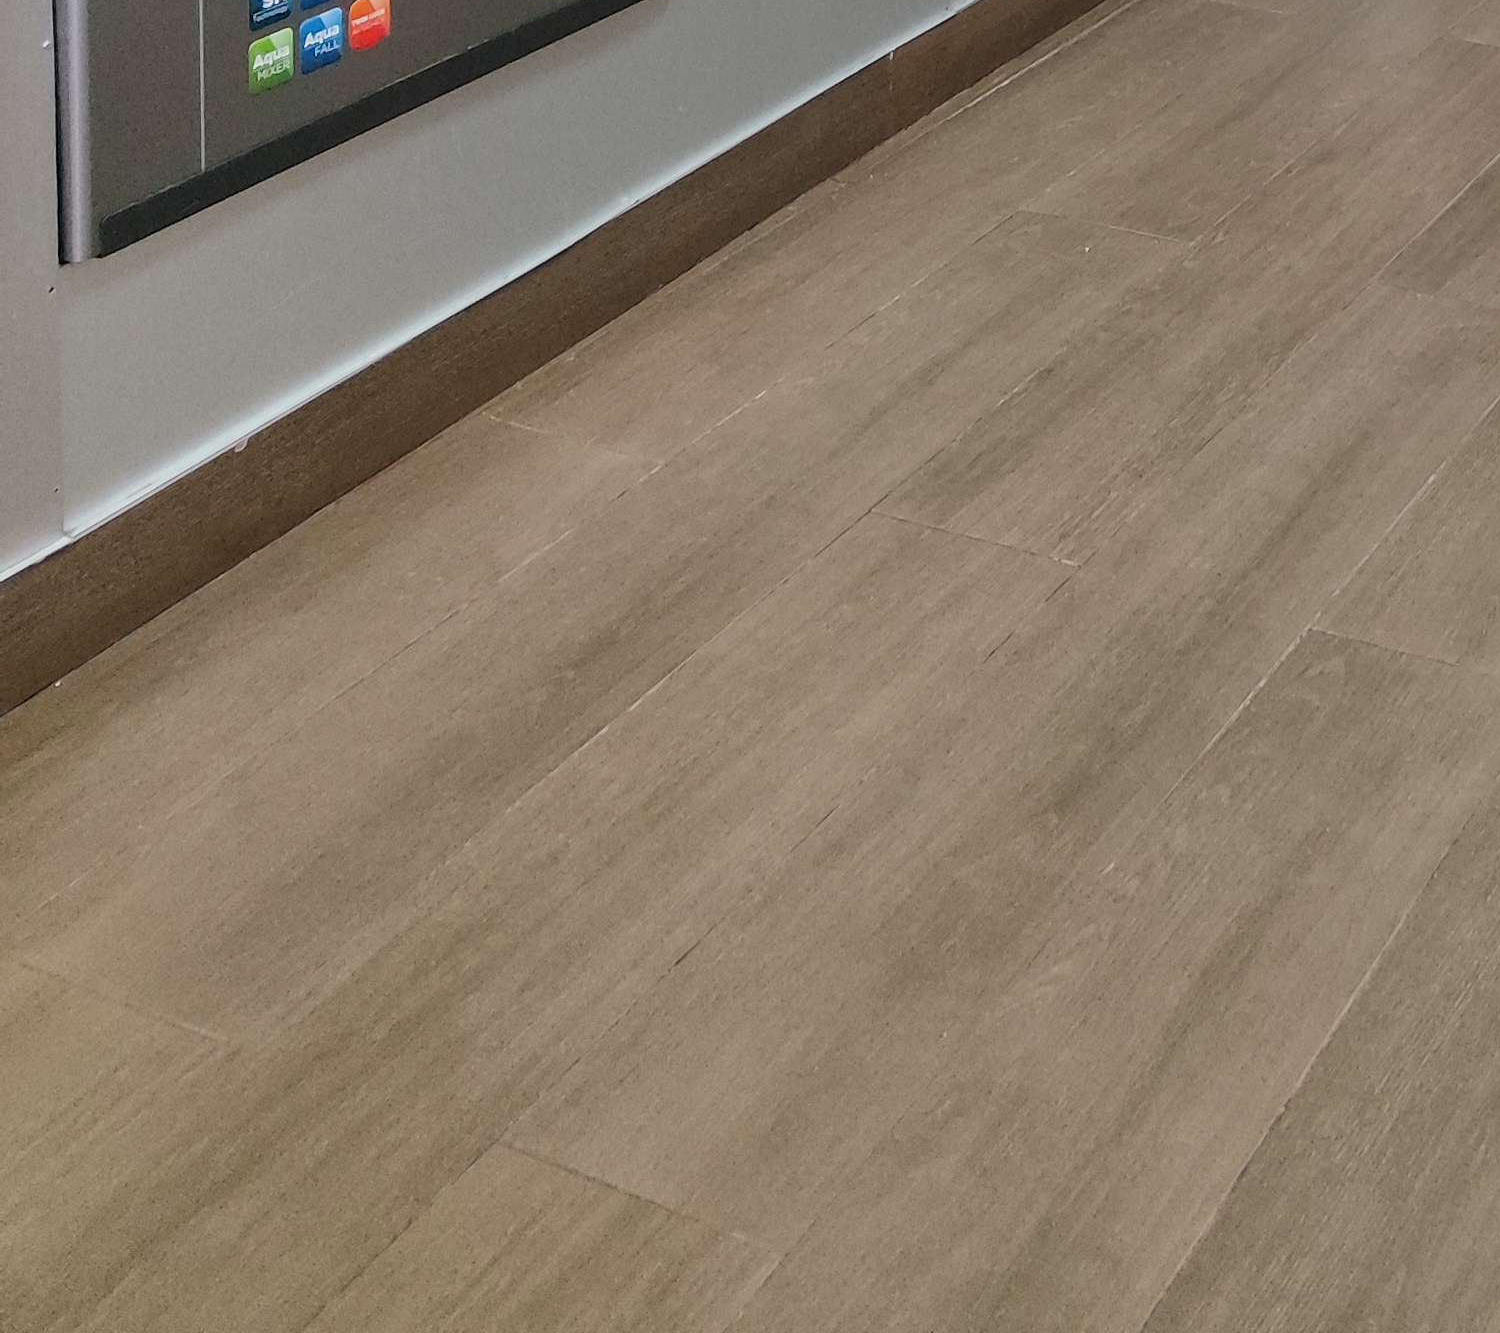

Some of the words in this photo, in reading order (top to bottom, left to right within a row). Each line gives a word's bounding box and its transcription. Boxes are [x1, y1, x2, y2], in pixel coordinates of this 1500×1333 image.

[304, 24, 340, 48] Aqua
[253, 45, 290, 70] Aqua
[314, 40, 340, 58] FALL
[257, 60, 291, 81] MIXER
